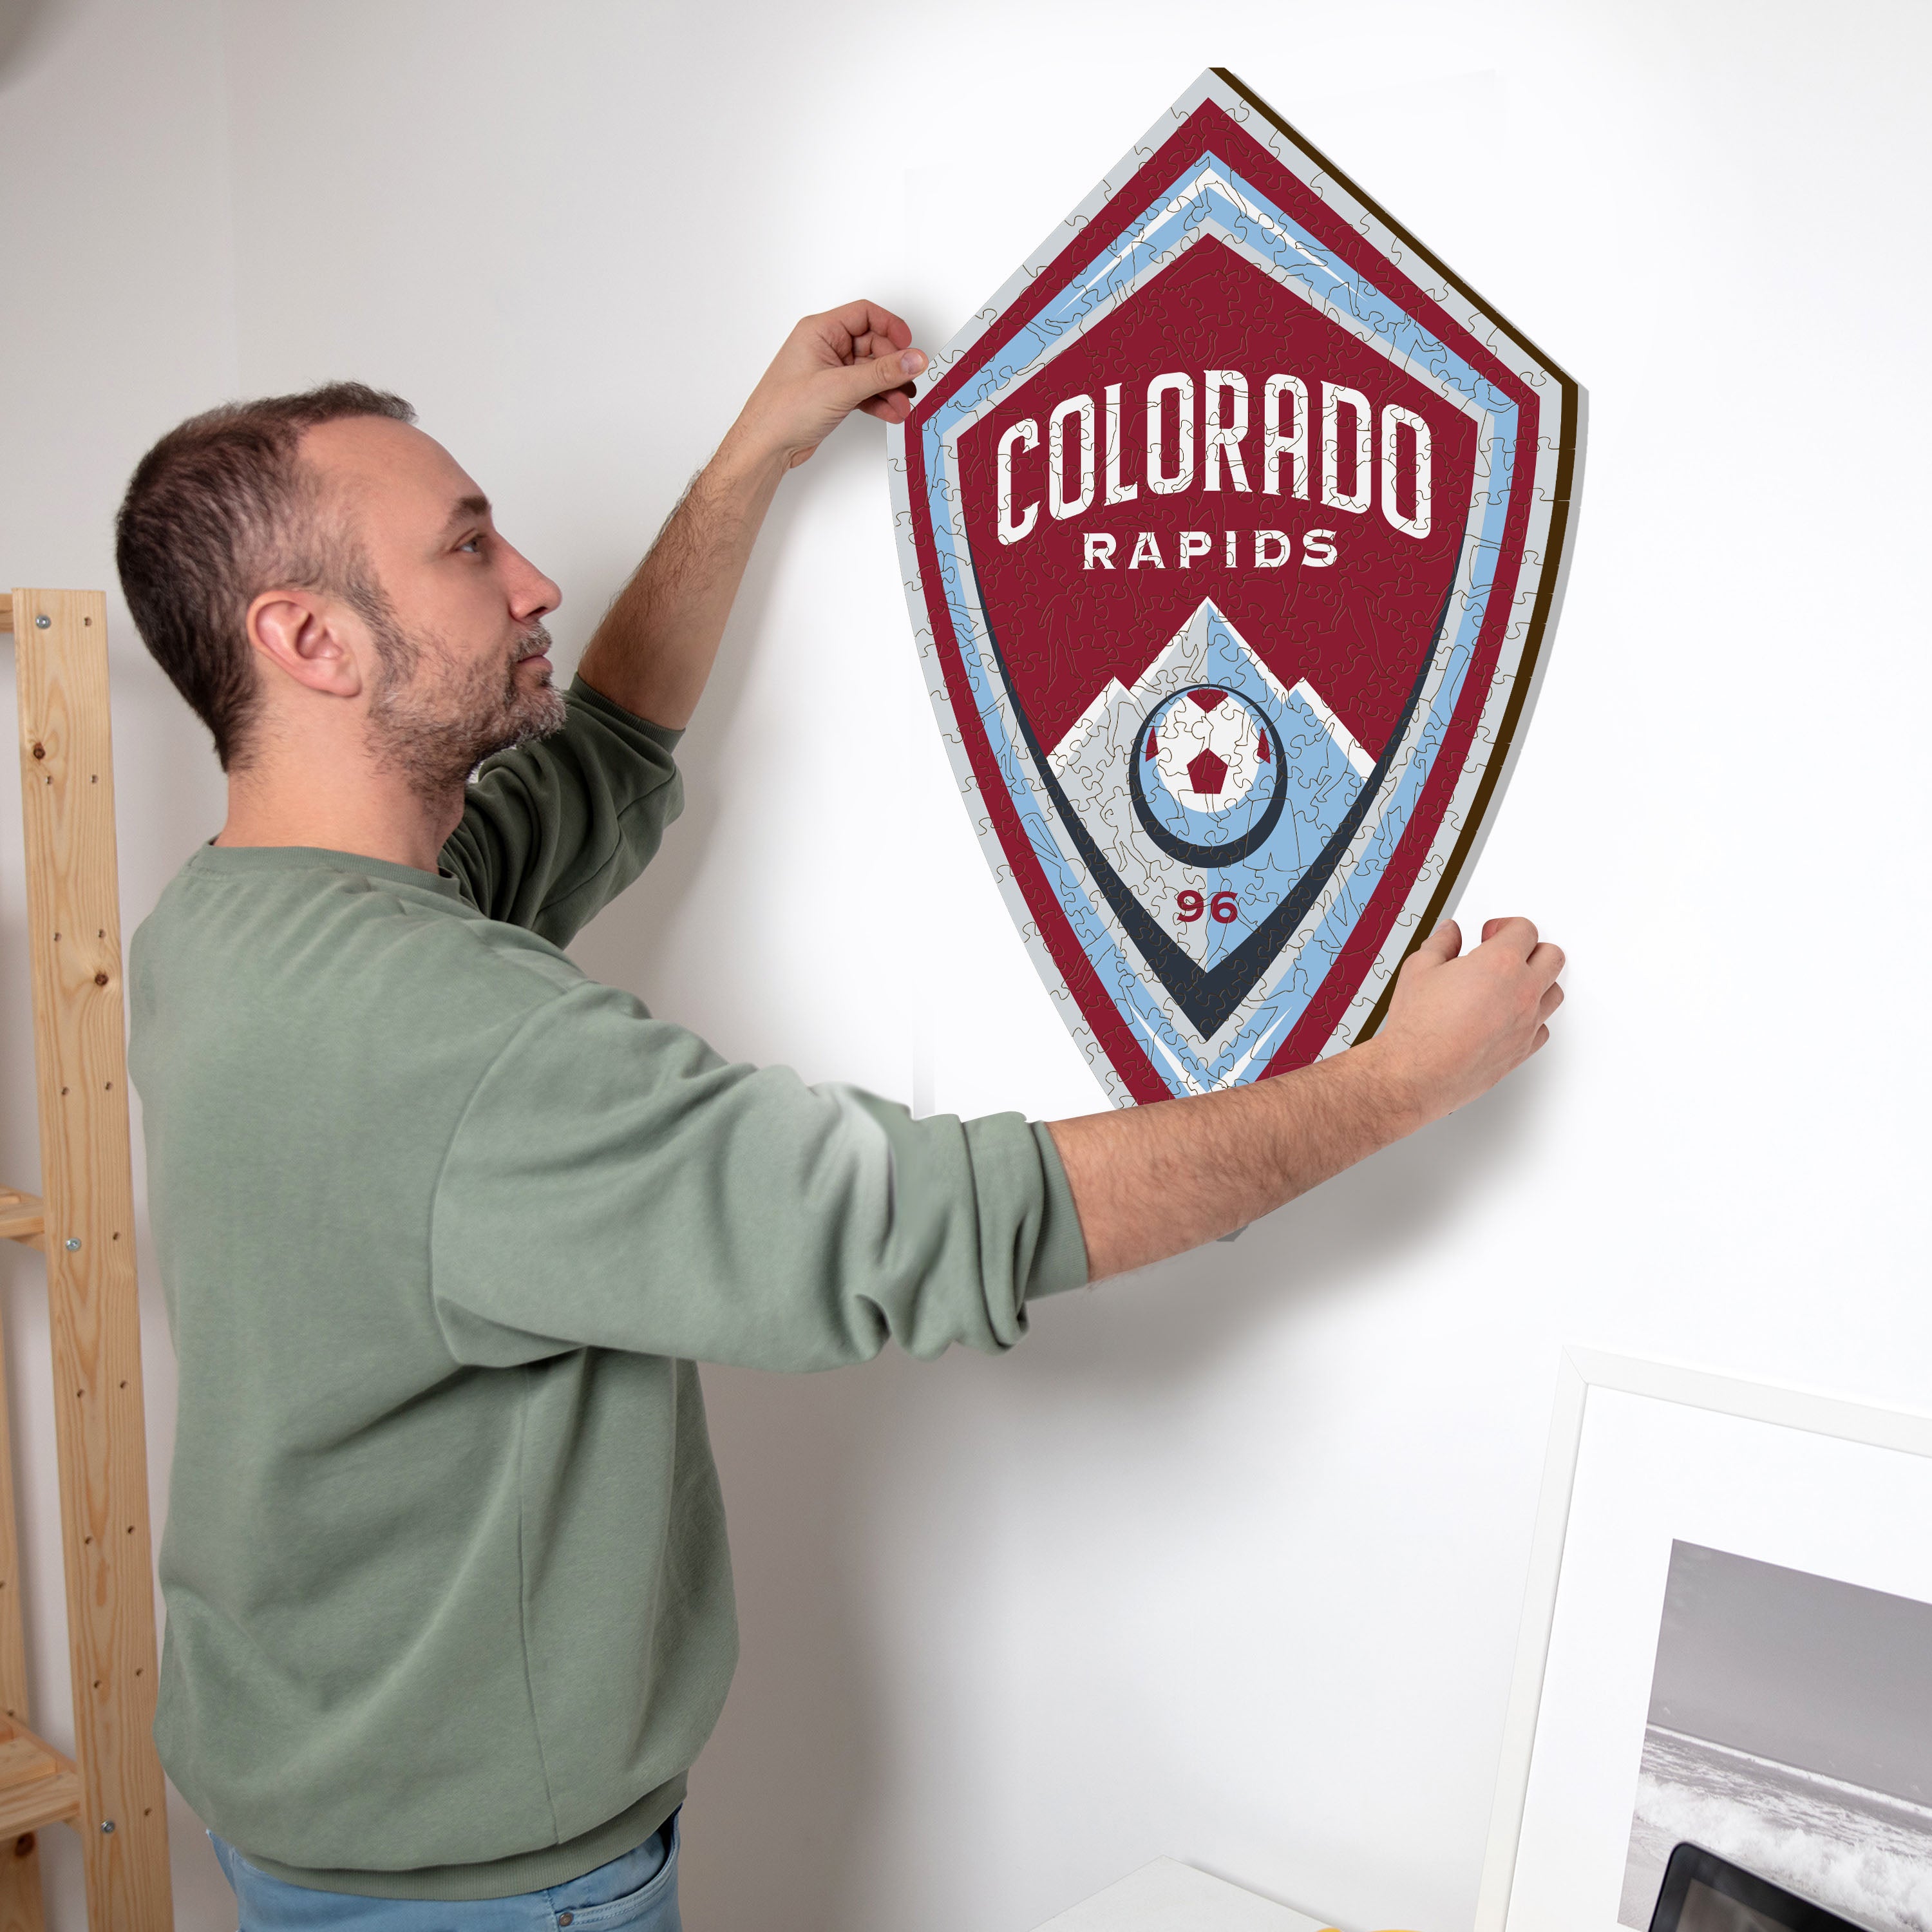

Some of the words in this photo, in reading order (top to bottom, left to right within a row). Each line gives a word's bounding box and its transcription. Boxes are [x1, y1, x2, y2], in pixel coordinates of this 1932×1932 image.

[997, 370, 1432, 545] COLORADO
[1082, 529, 1338, 570] RAPIDS
[1177, 889, 1238, 924] 96
